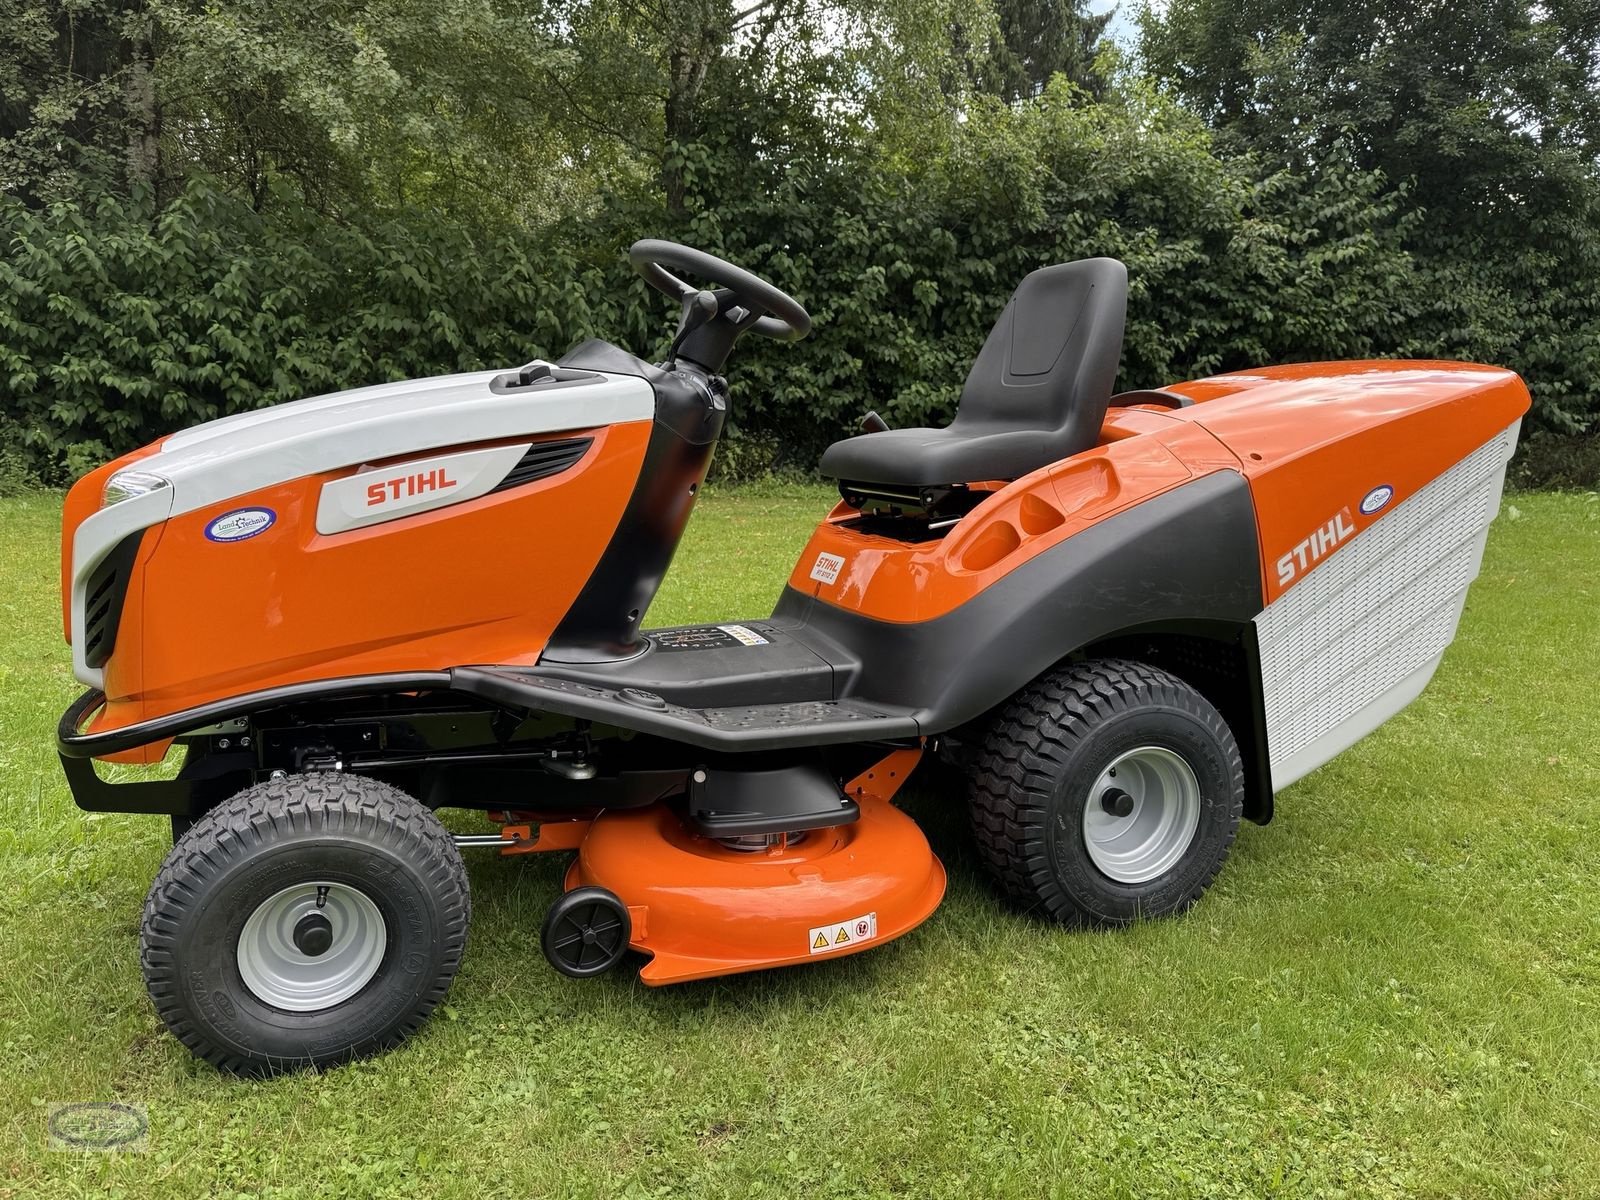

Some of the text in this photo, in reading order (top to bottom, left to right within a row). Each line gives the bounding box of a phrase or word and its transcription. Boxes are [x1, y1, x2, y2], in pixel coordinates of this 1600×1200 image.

[367, 469, 457, 506] STIHL
[218, 520, 235, 531] Land
[241, 515, 267, 528] Technik
[1278, 515, 1354, 586] STIHL
[816, 558, 838, 572] STIHL
